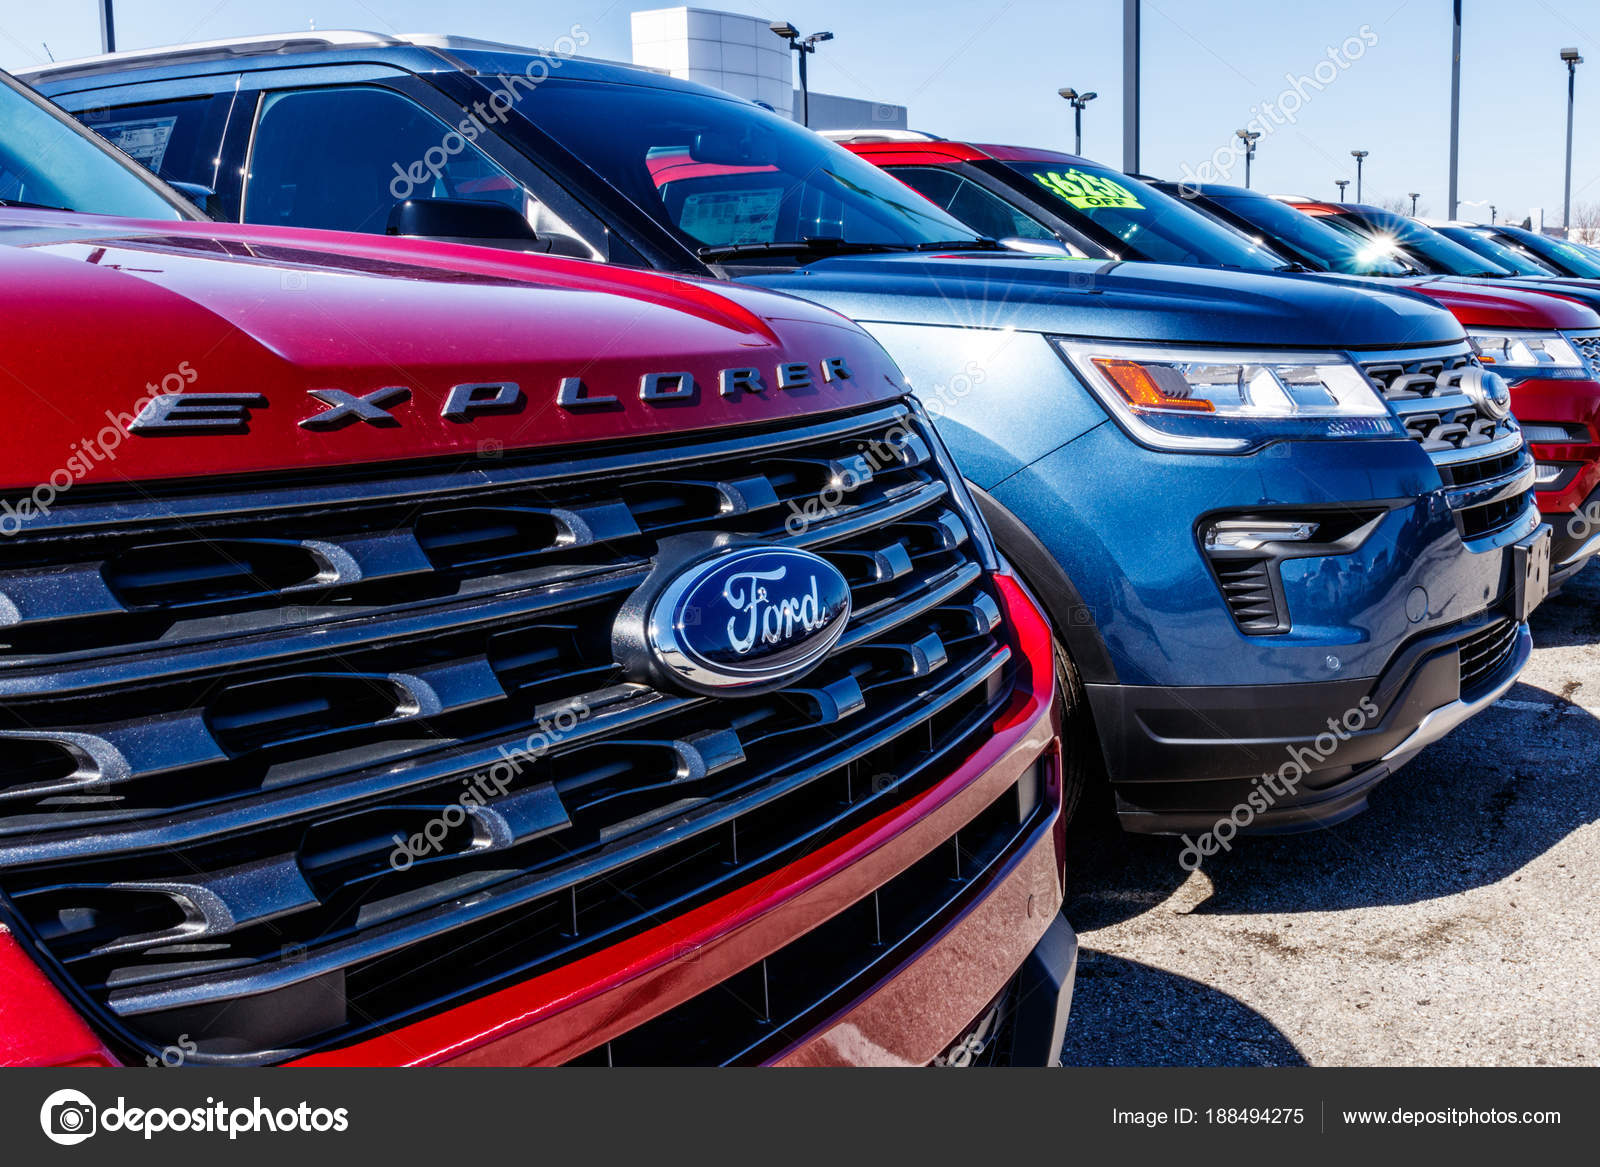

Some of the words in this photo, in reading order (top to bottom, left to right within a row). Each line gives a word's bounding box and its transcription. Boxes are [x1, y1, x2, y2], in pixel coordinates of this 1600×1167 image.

[1085, 197, 1126, 206] OFF
[127, 356, 852, 434] EXPLORER
[723, 565, 826, 654] Ford
